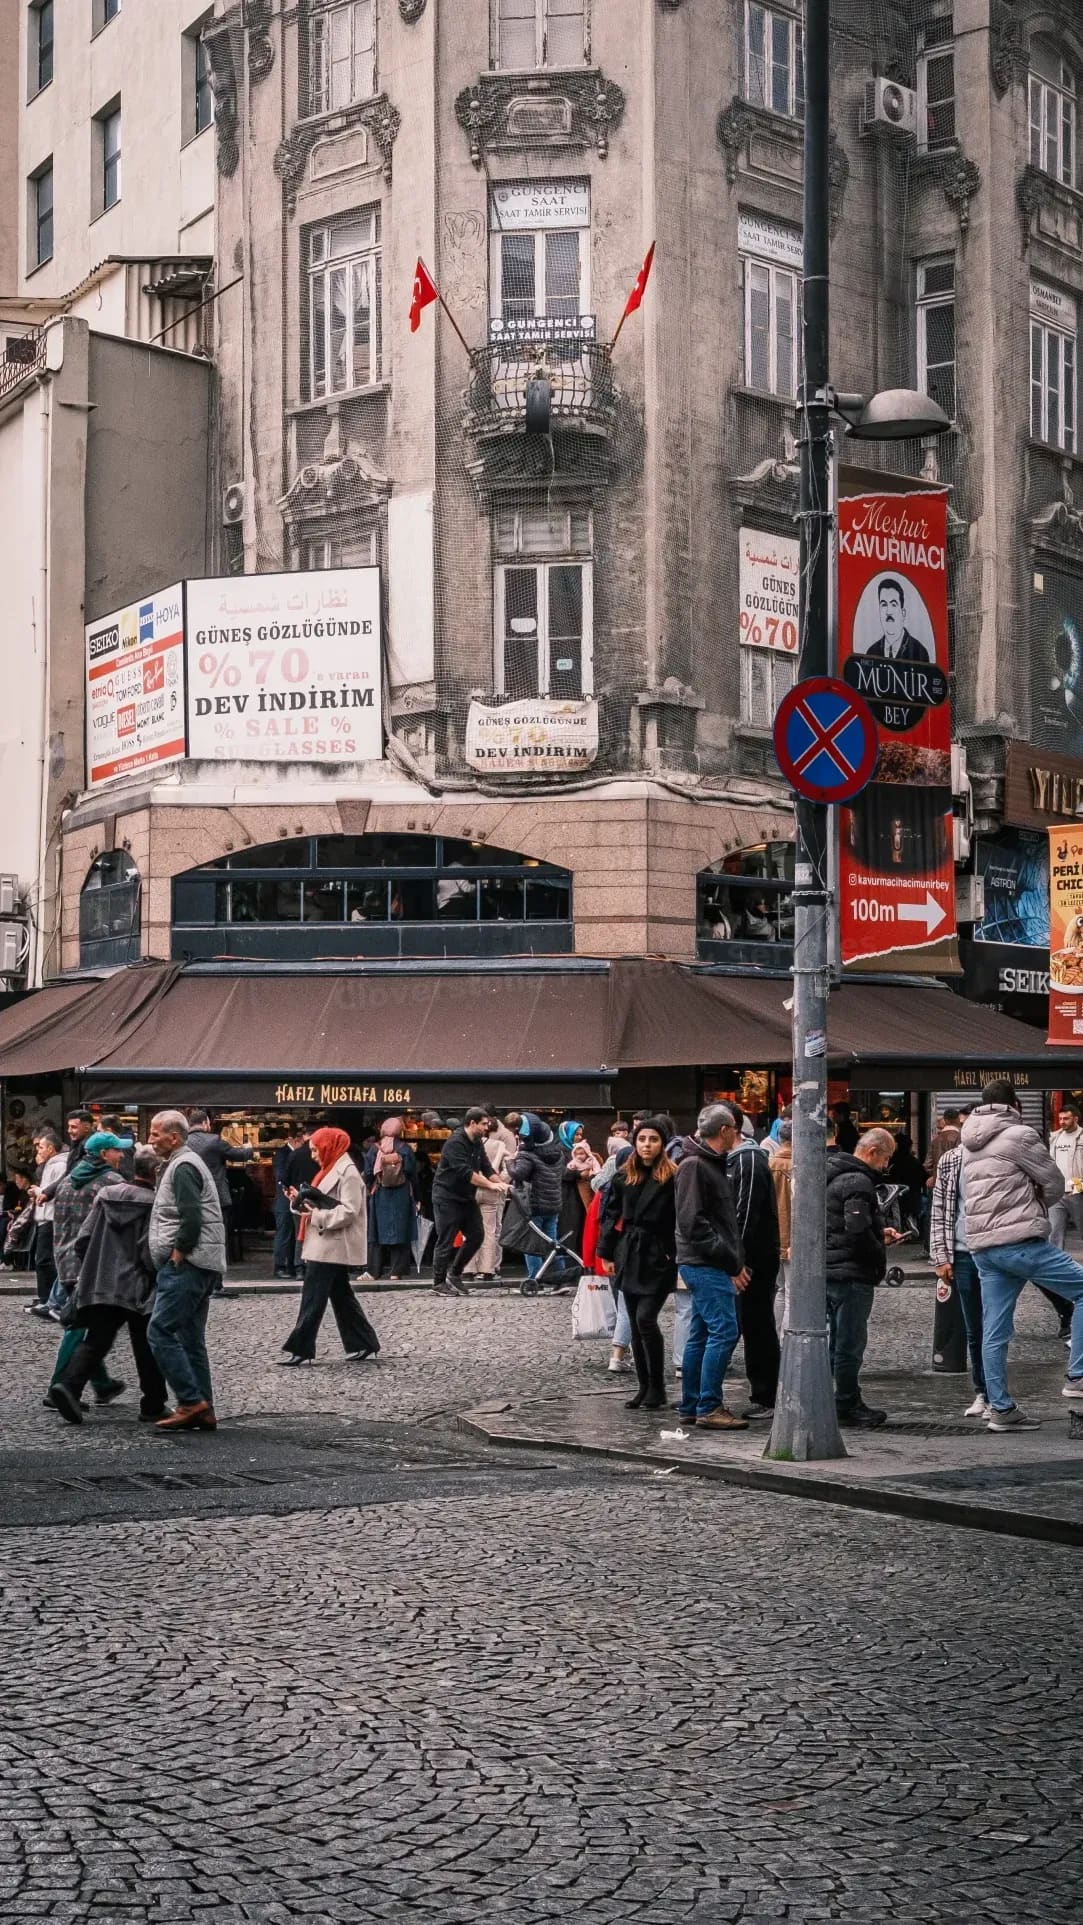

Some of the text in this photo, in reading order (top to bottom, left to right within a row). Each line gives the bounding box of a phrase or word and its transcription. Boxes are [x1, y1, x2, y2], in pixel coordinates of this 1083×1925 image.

[531, 196, 567, 206] SAAT
[499, 209, 521, 218] SAAT
[743, 230, 760, 241] SAAT
[490, 331, 516, 341] SAAT
[852, 500, 931, 541] Meşhur
[839, 529, 945, 570] KAVURMACI
[156, 604, 180, 626] HOYA
[195, 618, 373, 646] GÜNEŞ GÖZLÜĞÜNDE
[738, 611, 797, 650] %70
[89, 629, 119, 656] SEIKO
[122, 635, 137, 650] Nikon
[328, 671, 369, 680] varan
[855, 661, 938, 705] MÜNİR
[195, 694, 250, 716] DEV
[257, 683, 375, 712] İNDİRİM
[93, 711, 116, 729] VOGUE
[884, 706, 911, 726] BEY
[245, 716, 320, 738] SALE
[213, 739, 357, 760] SUGLASSES
[474, 744, 588, 758] DEV İNDİRİM
[1053, 861, 1080, 877] PERİ
[858, 874, 950, 893] kavurmacihacimunirbey
[990, 876, 1018, 891] ASTRON
[850, 898, 896, 923] 100m
[1001, 967, 1050, 995] SEIK
[953, 1069, 977, 1089] HAFIZ
[1013, 1072, 1030, 1087] 1864
[275, 1083, 411, 1105] HAFIZ MUSTAFA 1864
